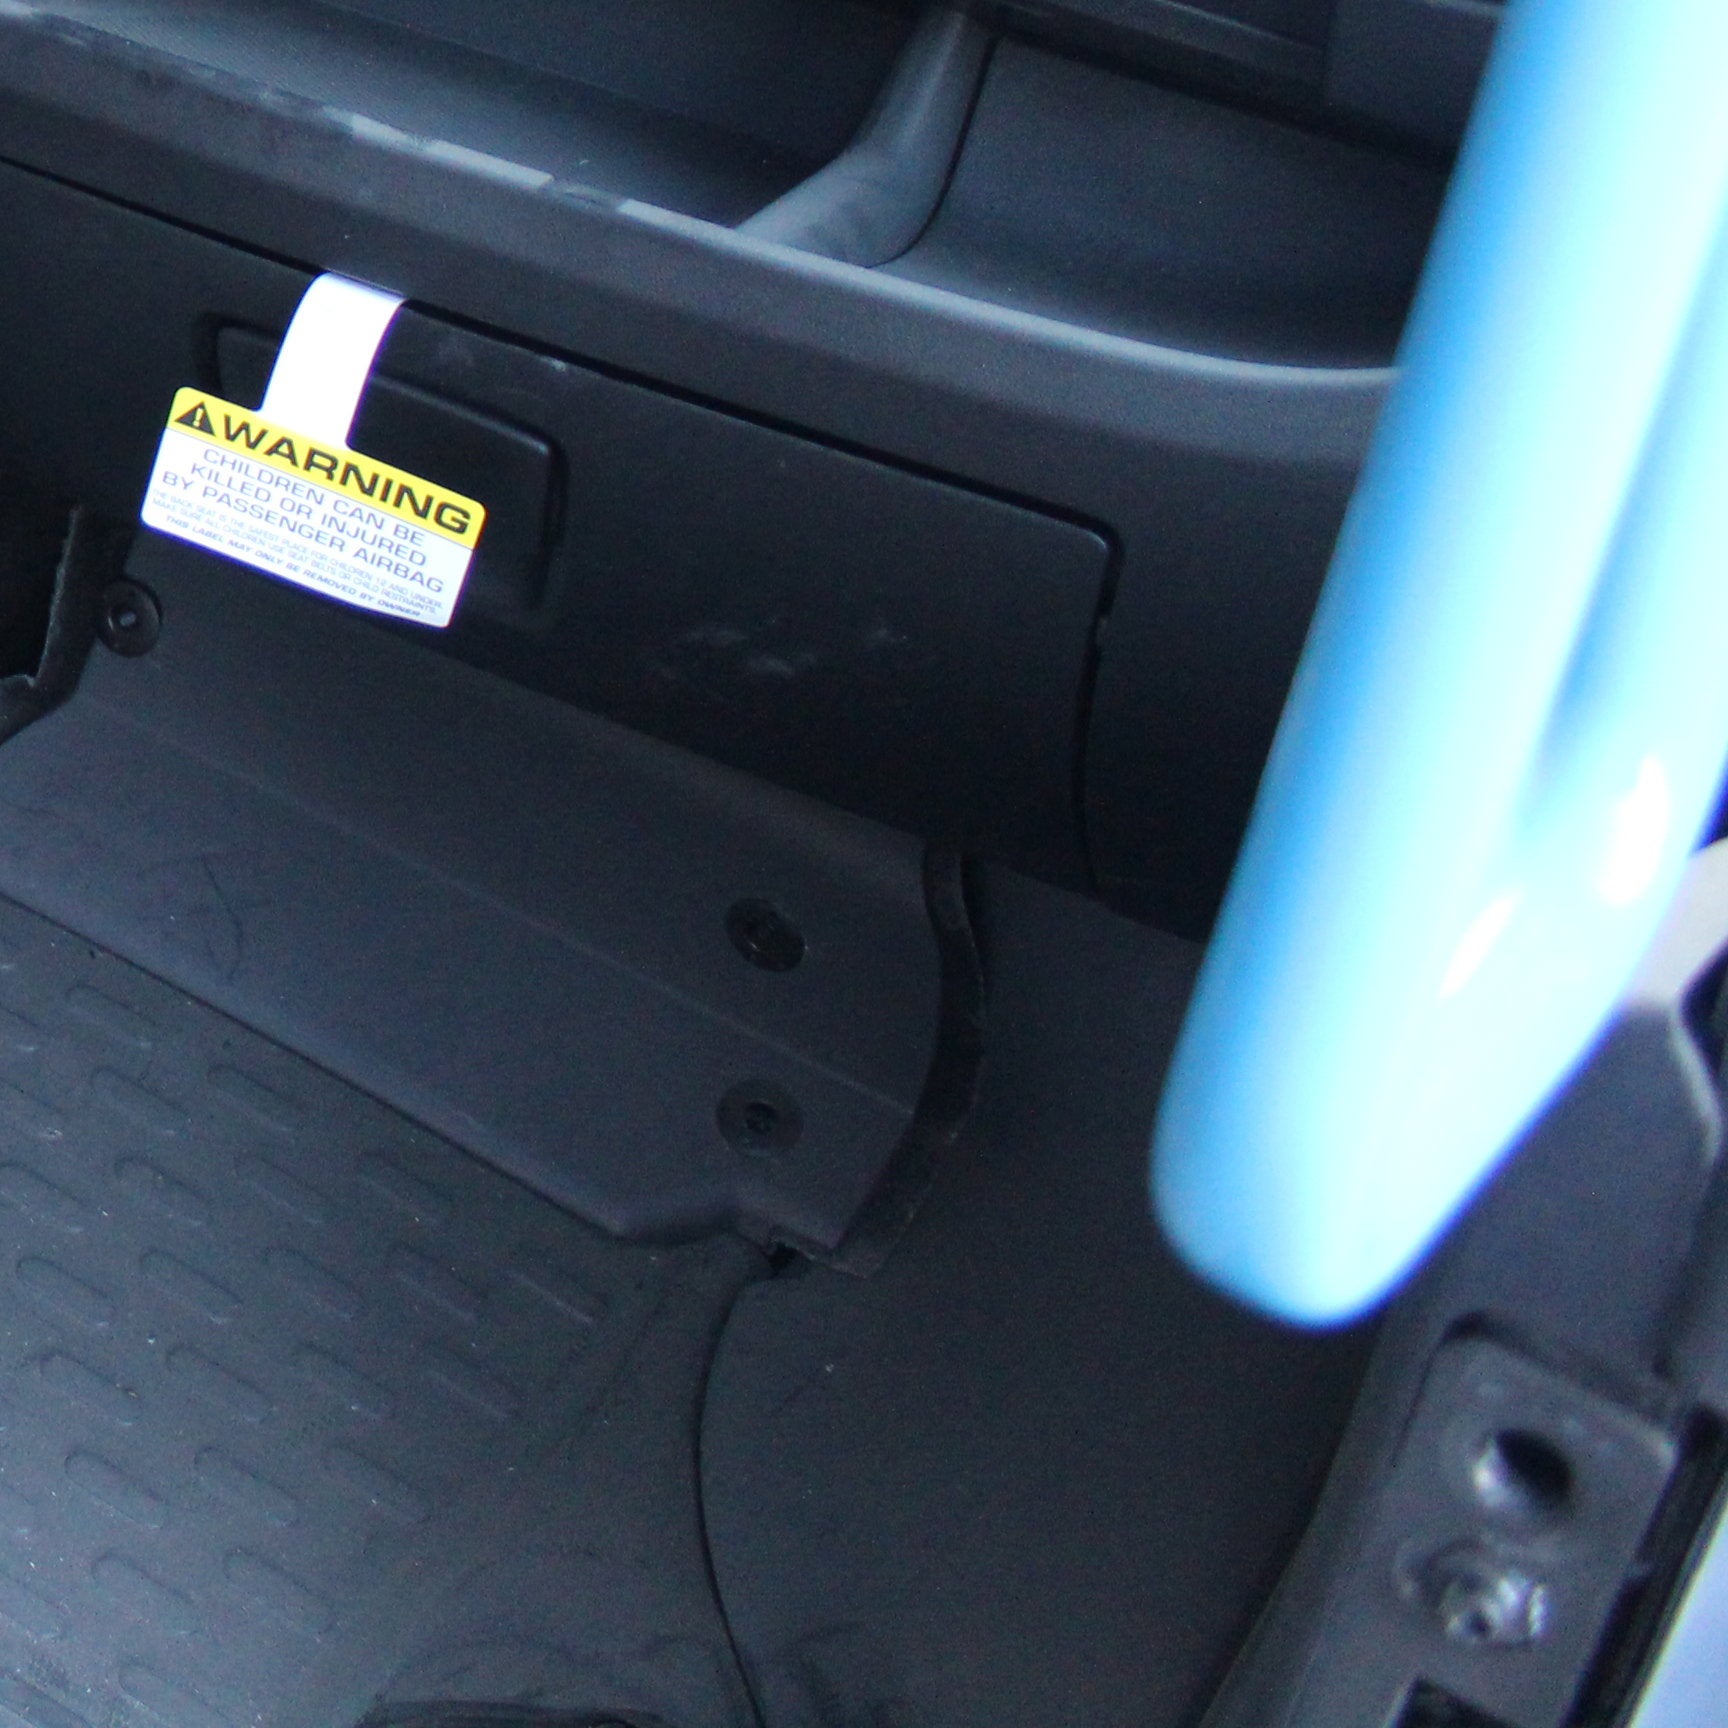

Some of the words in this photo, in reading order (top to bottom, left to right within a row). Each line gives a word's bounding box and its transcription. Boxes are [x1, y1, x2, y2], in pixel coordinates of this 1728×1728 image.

[191, 463, 272, 503] KILLED
[280, 497, 313, 520] OR
[321, 513, 427, 566] INJURED
[203, 448, 324, 506] CHILDREN
[333, 499, 385, 530] CAN
[394, 523, 425, 547] BE
[224, 413, 471, 535] WARNING
[162, 470, 194, 491] BY
[201, 485, 346, 553] PASSENGER
[353, 547, 444, 593] AIRBAG
[166, 514, 190, 529] THIS
[192, 525, 225, 544] LABEL
[227, 539, 253, 554] MAY
[255, 550, 284, 565] ONLY
[286, 562, 302, 573] BE
[303, 569, 357, 595] REMOVED
[359, 592, 375, 602] BY
[377, 598, 421, 616] OWNER
